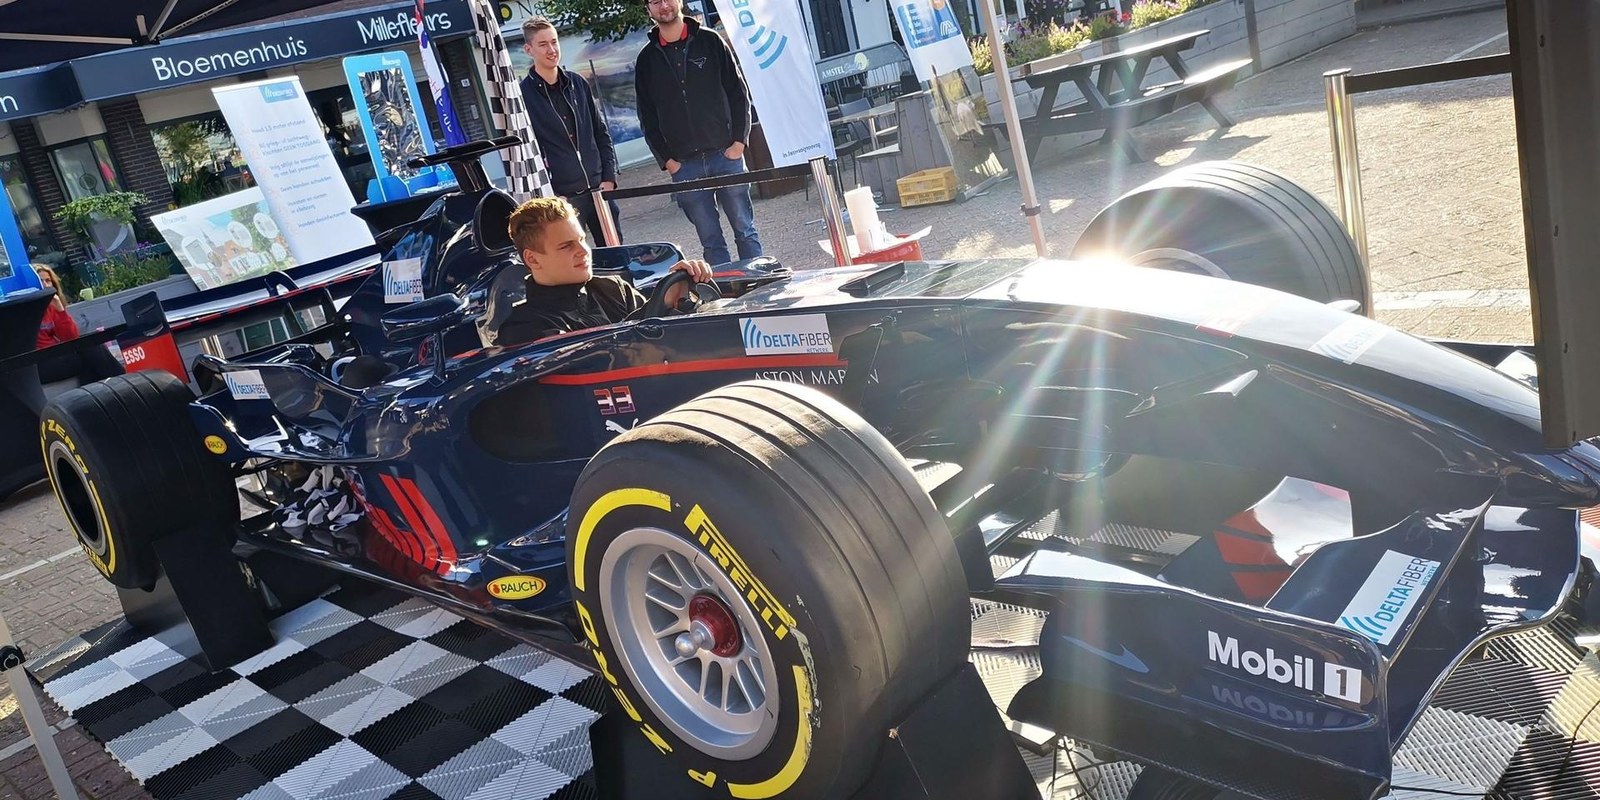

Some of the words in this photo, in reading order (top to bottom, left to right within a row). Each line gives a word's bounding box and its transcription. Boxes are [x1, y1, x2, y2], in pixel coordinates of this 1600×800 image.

[357, 12, 452, 44] Millefleurs
[152, 37, 308, 81] Bloemenhuis
[821, 66, 845, 80] AMSTEL
[123, 346, 146, 365] ESSO
[811, 369, 880, 384] MARN
[594, 386, 636, 415] 33
[684, 504, 797, 640] PIRELLI
[501, 582, 538, 593] RAUCH
[1208, 630, 1314, 691] Mobil
[576, 600, 673, 755] ZERO
